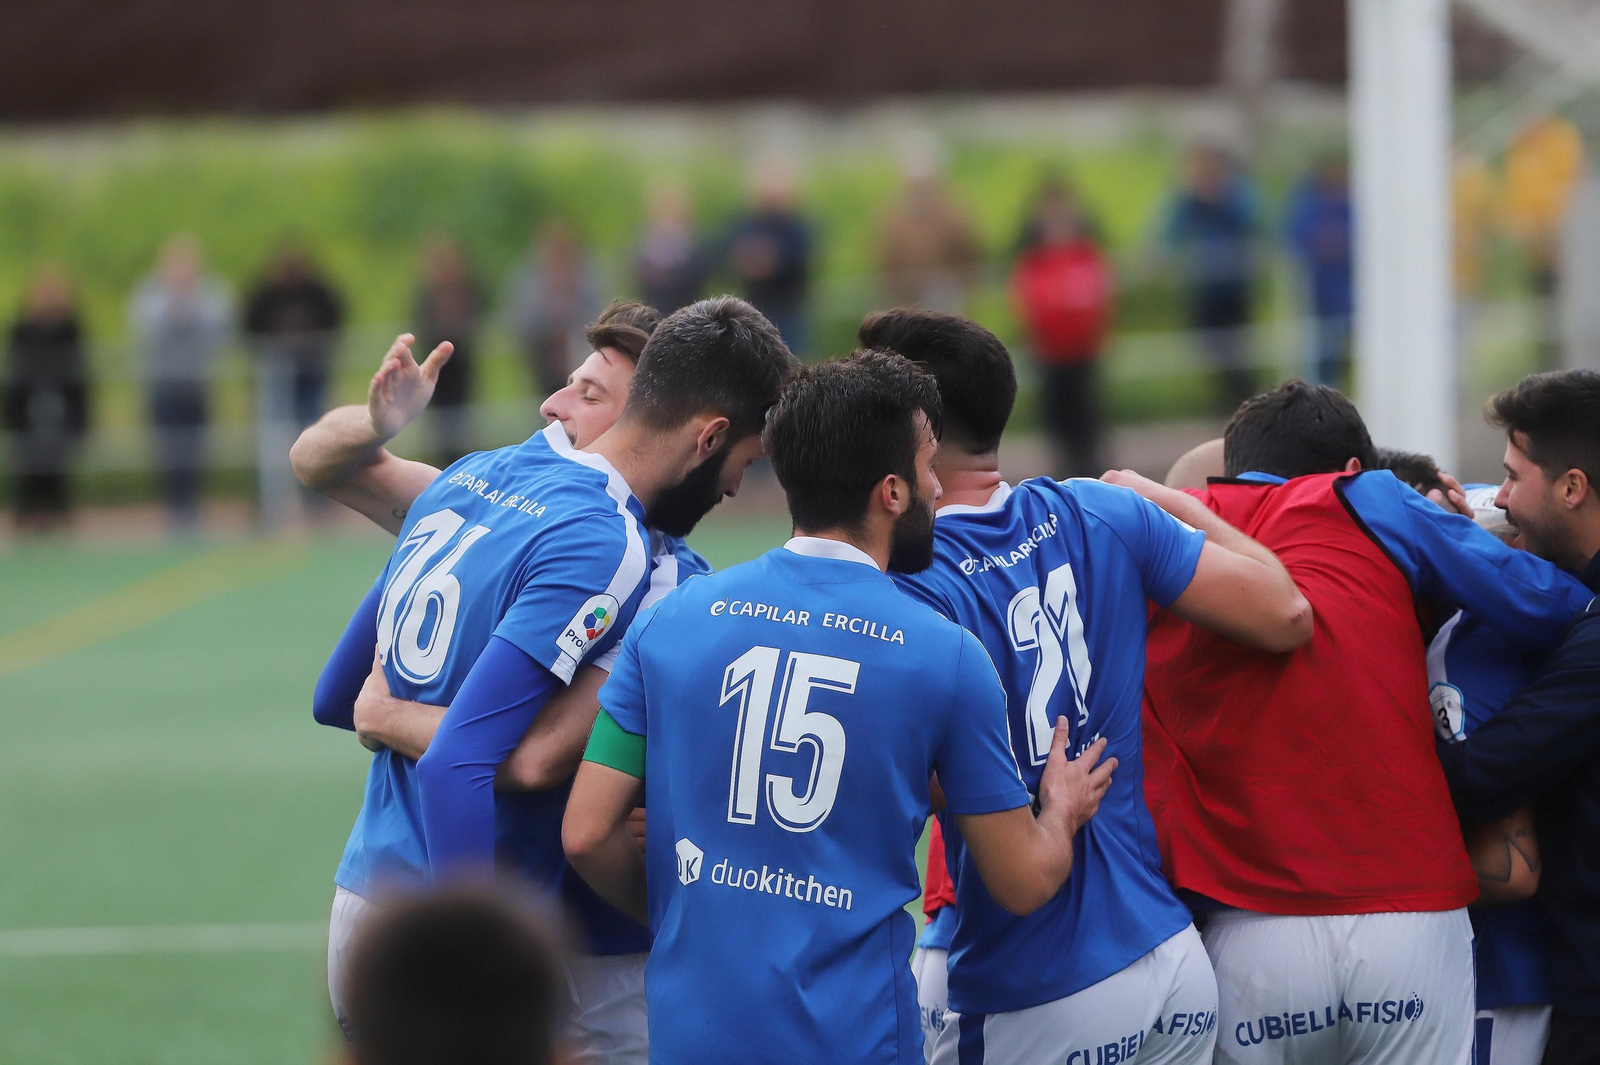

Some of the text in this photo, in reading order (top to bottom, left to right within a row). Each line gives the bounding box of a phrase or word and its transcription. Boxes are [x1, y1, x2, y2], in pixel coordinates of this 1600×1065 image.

[376, 508, 491, 684] 16
[728, 599, 905, 645] CAPILAR ERCILLA
[1007, 562, 1092, 766] 21
[718, 645, 861, 833] 15
[710, 858, 853, 910] duokitchen
